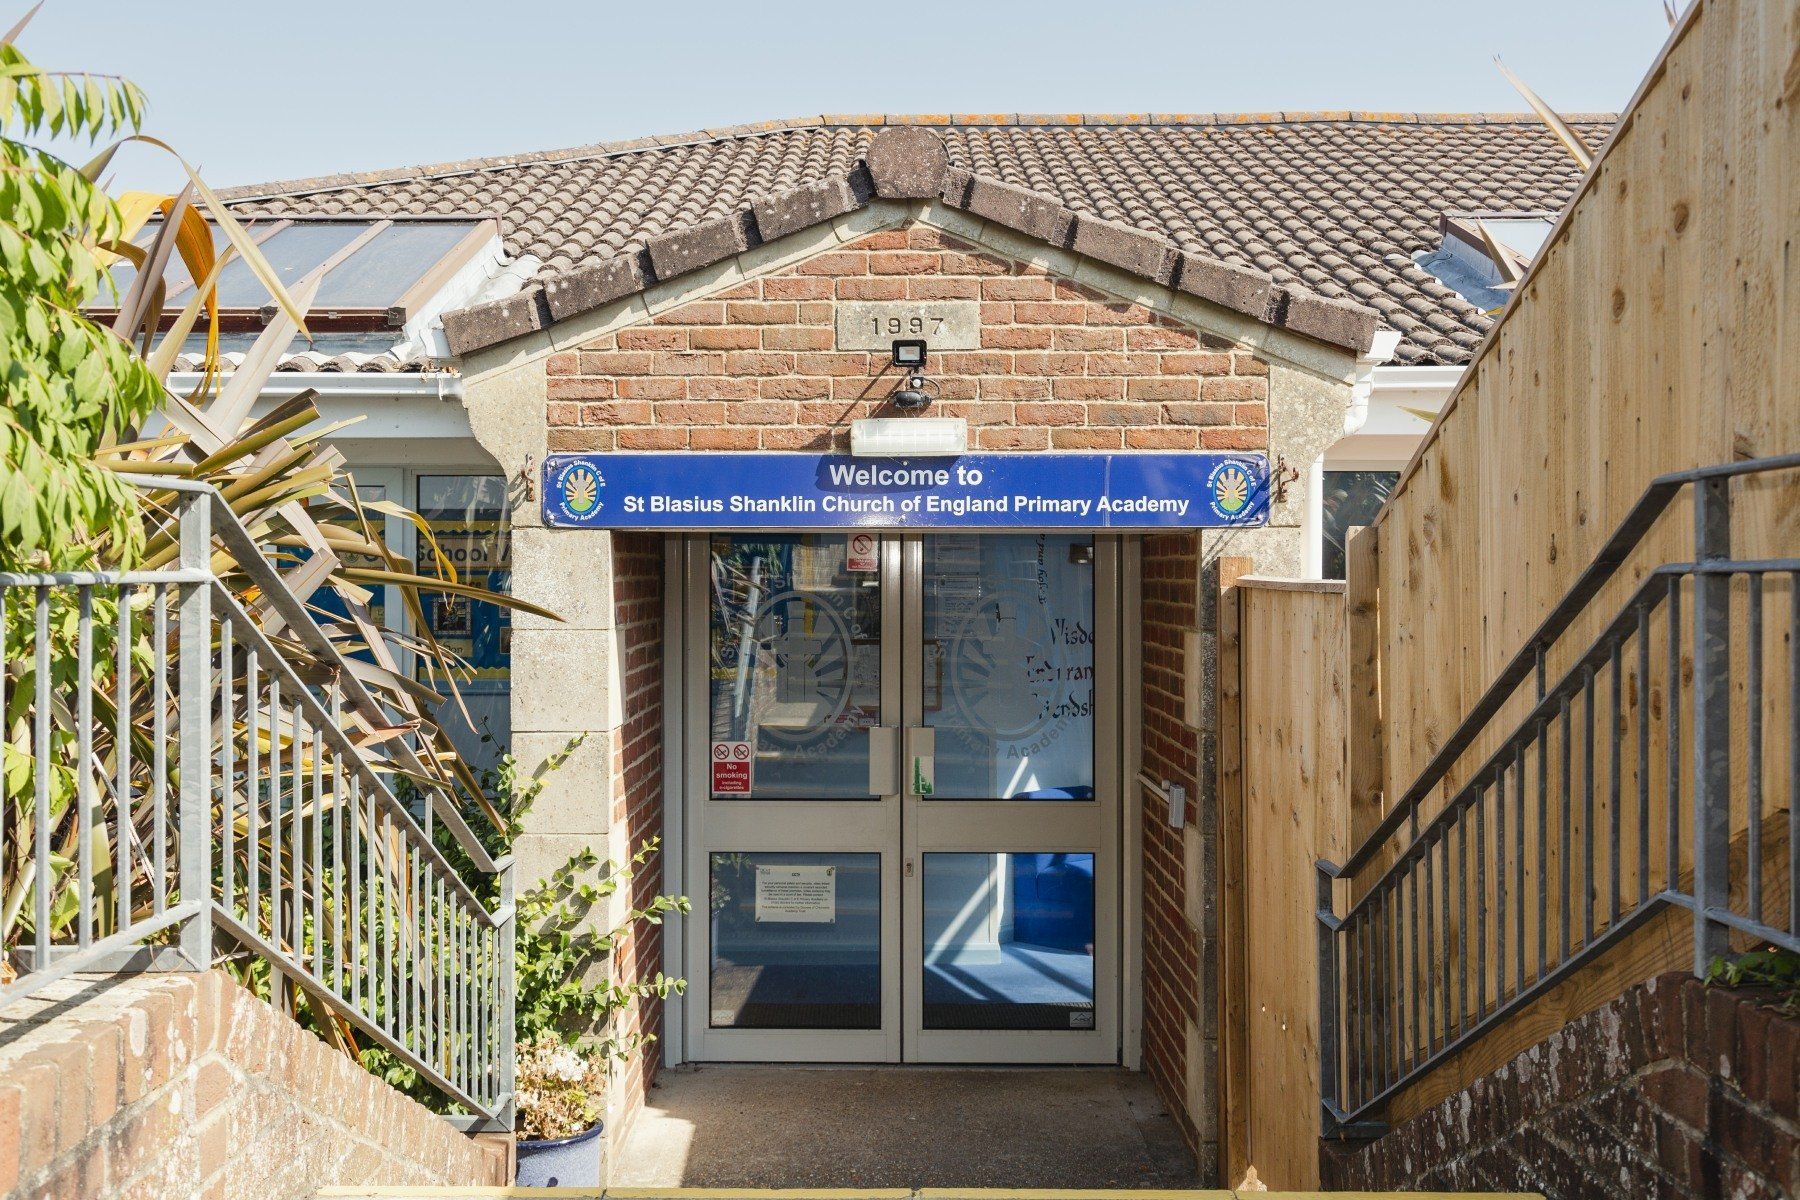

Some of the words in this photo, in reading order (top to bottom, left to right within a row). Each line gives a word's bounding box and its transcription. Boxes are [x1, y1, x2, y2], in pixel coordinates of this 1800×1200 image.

[871, 316, 945, 335] 1997
[829, 464, 949, 486] Welcome
[956, 464, 983, 486] to
[559, 501, 579, 521] Primary
[580, 501, 604, 521] Academy
[623, 495, 644, 513] St
[651, 495, 723, 513] Blasius
[730, 495, 816, 513] Shanklin
[822, 495, 895, 513] Church
[901, 495, 921, 513] of
[927, 495, 1007, 518] England
[1015, 495, 1090, 517] Primary
[1096, 495, 1189, 517] Academy
[1210, 501, 1229, 521] Primary
[1230, 501, 1255, 520] Academy
[715, 772, 748, 780] smoking
